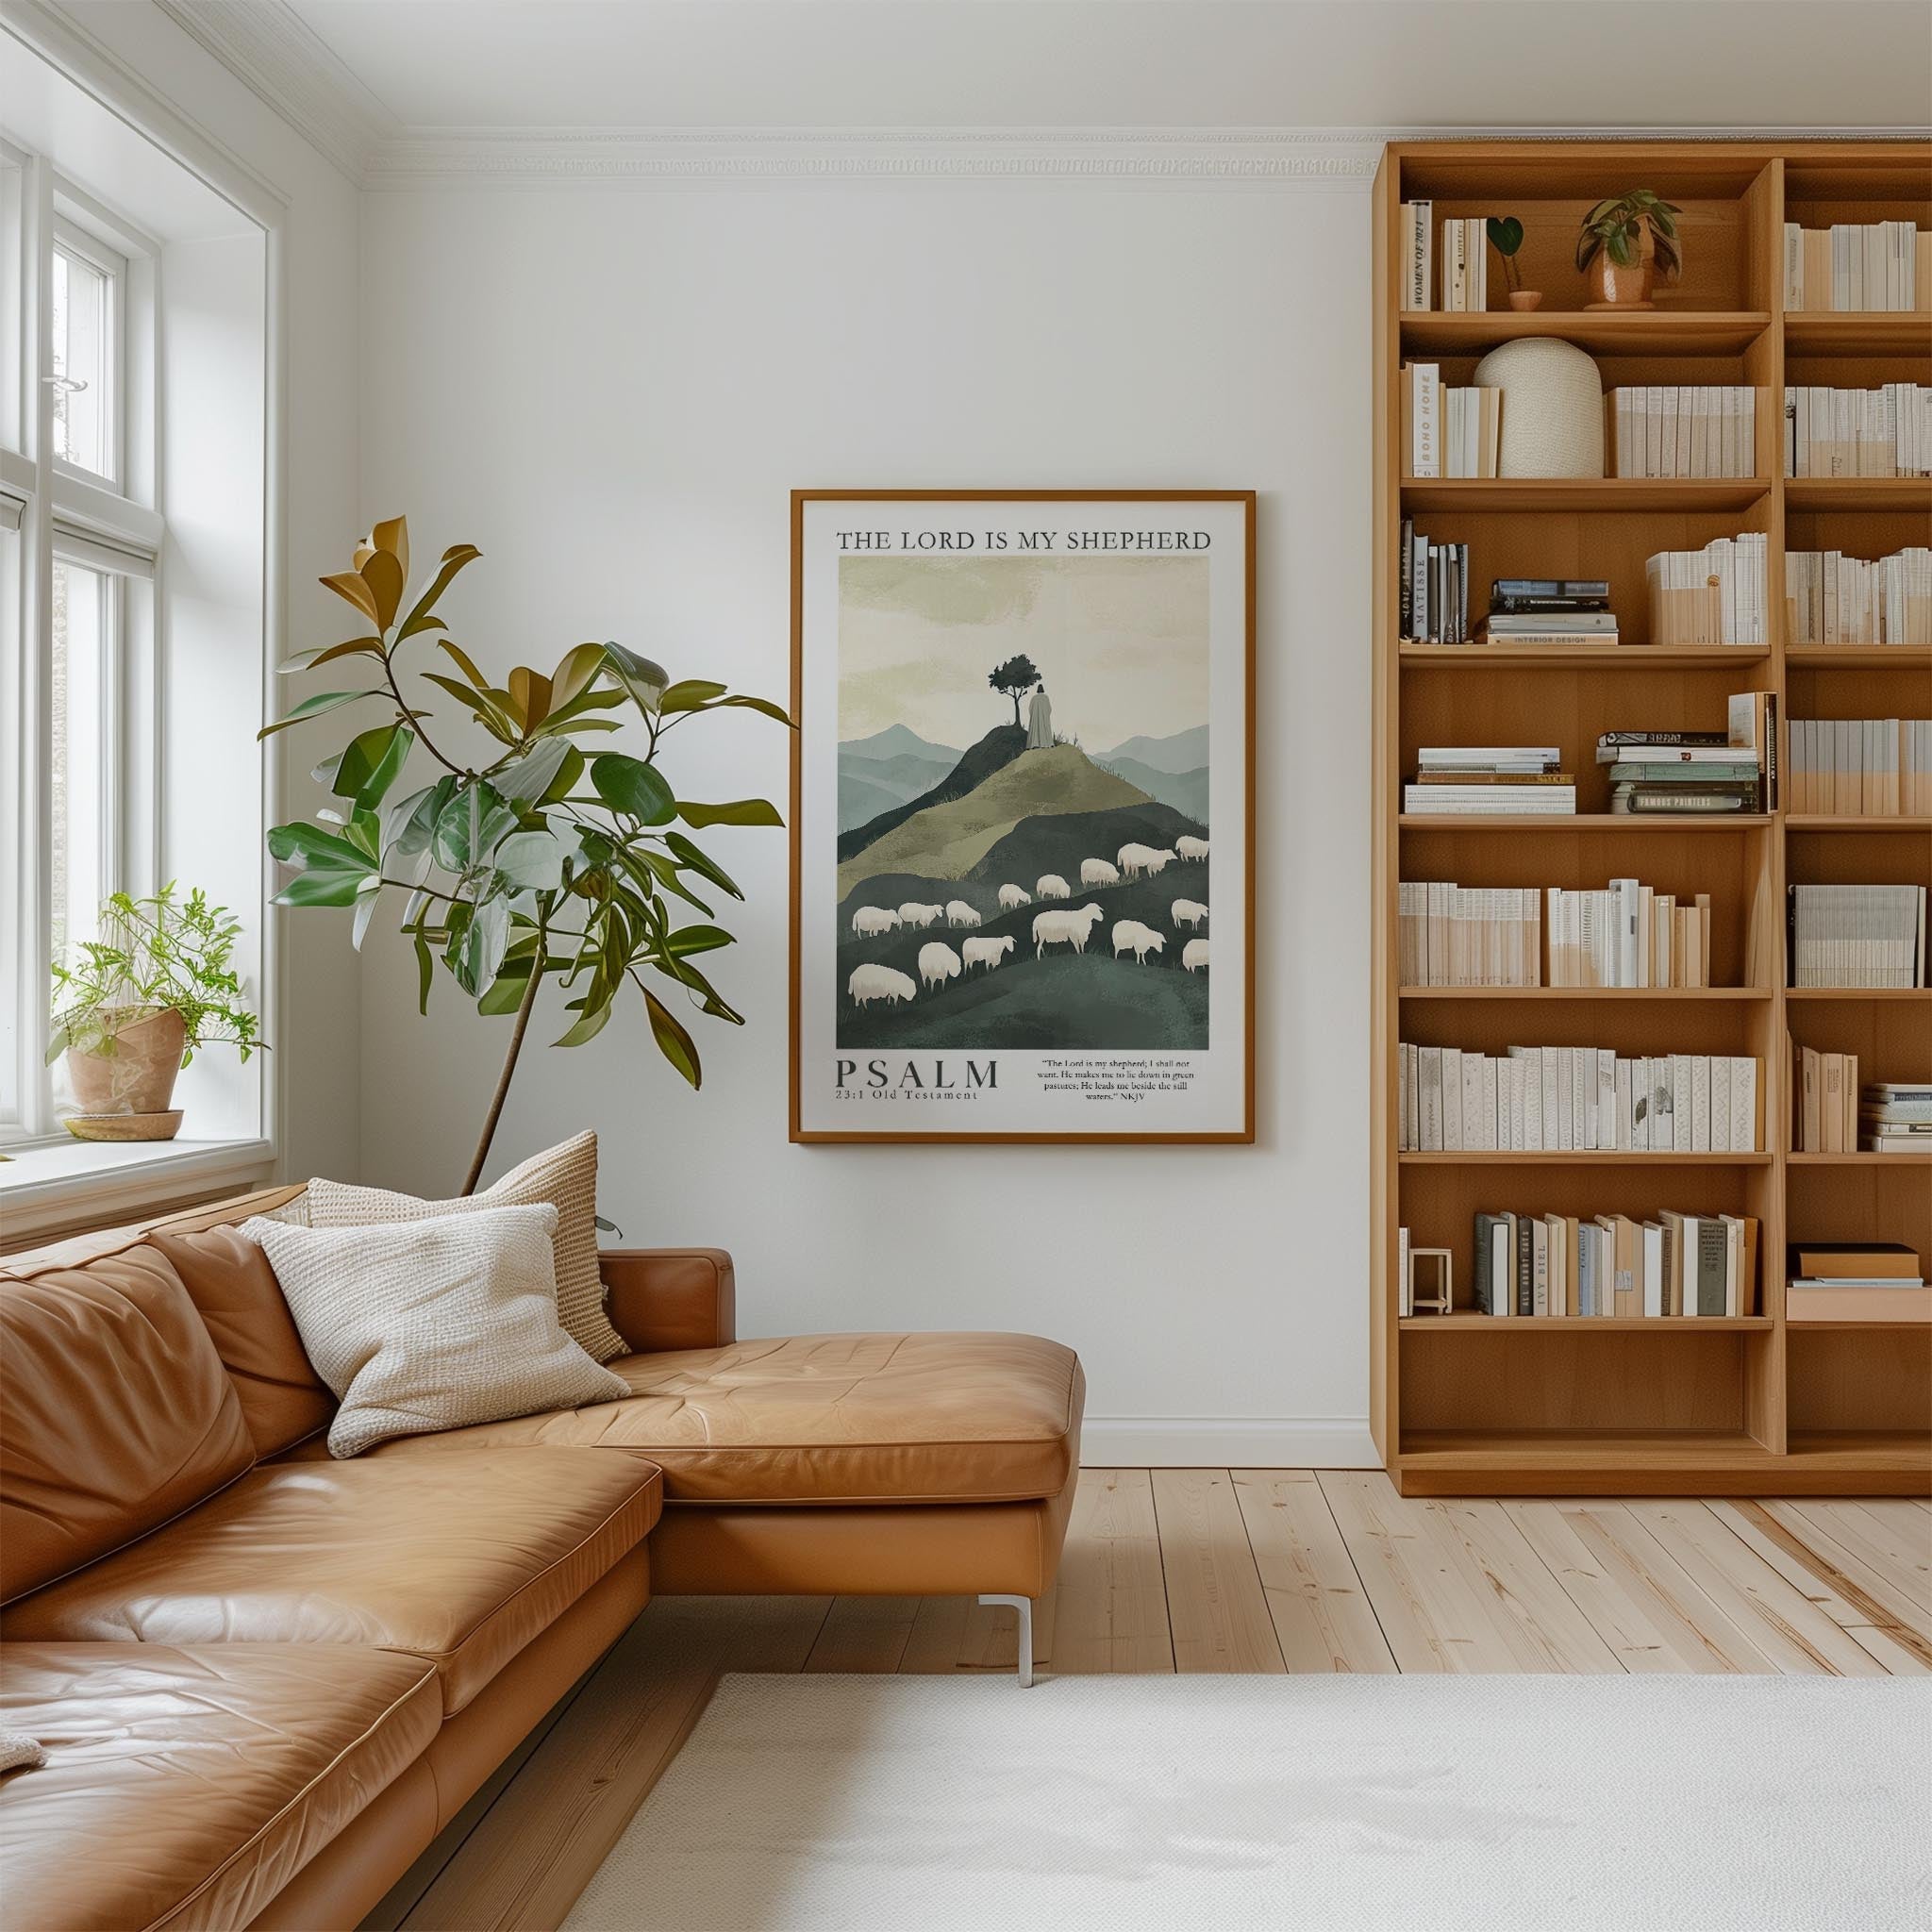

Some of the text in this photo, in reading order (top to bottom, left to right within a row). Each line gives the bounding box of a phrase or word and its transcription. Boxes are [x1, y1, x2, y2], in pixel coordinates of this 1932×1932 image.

[1415, 244, 1424, 260] OF
[1414, 263, 1424, 305] WOMEN
[1422, 375, 1430, 461] BOHO HOME
[837, 531, 1211, 550] THE LORD IS MY SHEPHERD
[1640, 797, 1672, 808] FAMOUS
[1064, 1059, 1084, 1068] Lord
[1086, 1059, 1093, 1068] is
[1094, 1061, 1108, 1070] my
[1109, 1059, 1148, 1070] shepherd;
[1156, 1059, 1174, 1068] shall
[836, 1059, 998, 1089] PSALM
[1037, 1070, 1194, 1081] want. He makes me to lie down in green
[1080, 1081, 1093, 1091] He
[1094, 1081, 1115, 1091] leads
[1131, 1081, 1157, 1091] beside
[1158, 1081, 1172, 1091] the
[1173, 1081, 1188, 1091] still
[835, 1090, 977, 1100] 23:1 Old Testament
[1120, 1092, 1145, 1103] NKJV
[1538, 1245, 1546, 1274] BIEL
